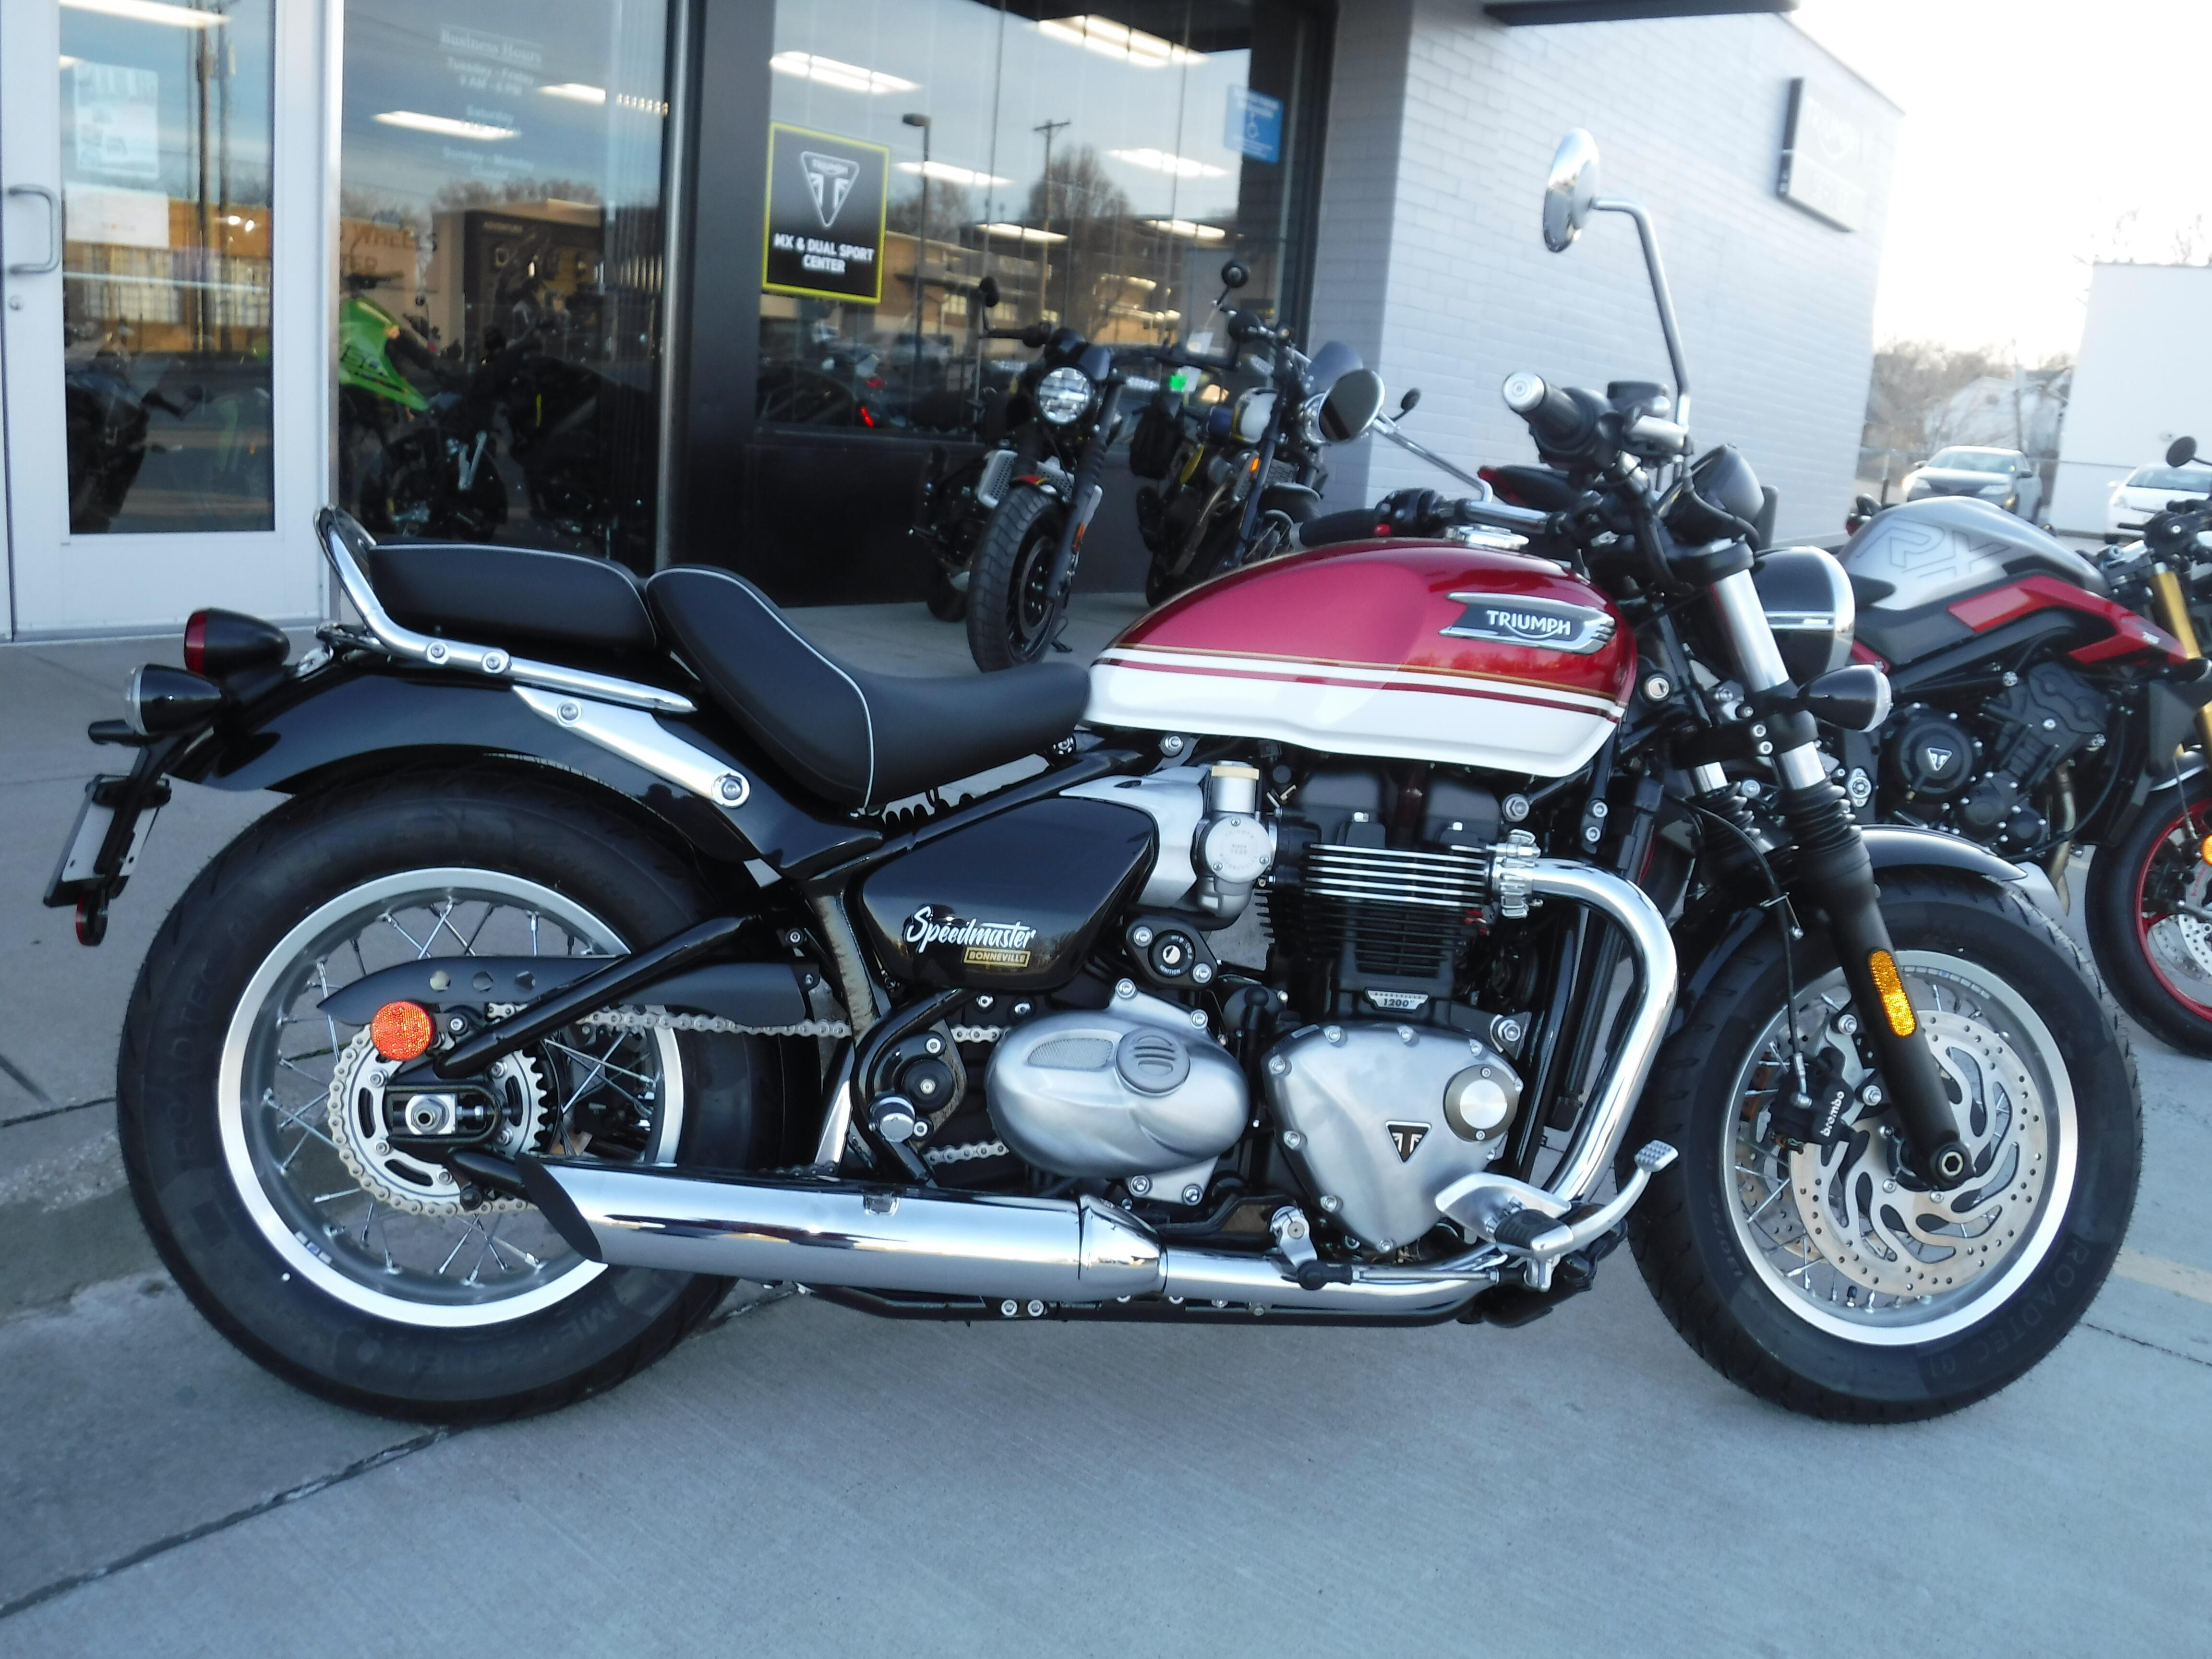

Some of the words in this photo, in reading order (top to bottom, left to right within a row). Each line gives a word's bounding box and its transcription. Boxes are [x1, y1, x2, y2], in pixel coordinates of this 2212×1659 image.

[773, 233, 794, 248] MX
[795, 236, 805, 251] &
[807, 237, 837, 255] DUAL
[839, 243, 875, 262] SPORT
[802, 253, 846, 273] CENTER
[1486, 609, 1571, 639] TRIUMPH
[906, 905, 1036, 953] Speedmaster
[968, 950, 1026, 963] BONNEVILLE
[1383, 998, 1409, 1007] 1200
[1820, 1091, 1845, 1137] brembo
[1970, 1238, 2092, 1363] ROADTEC
